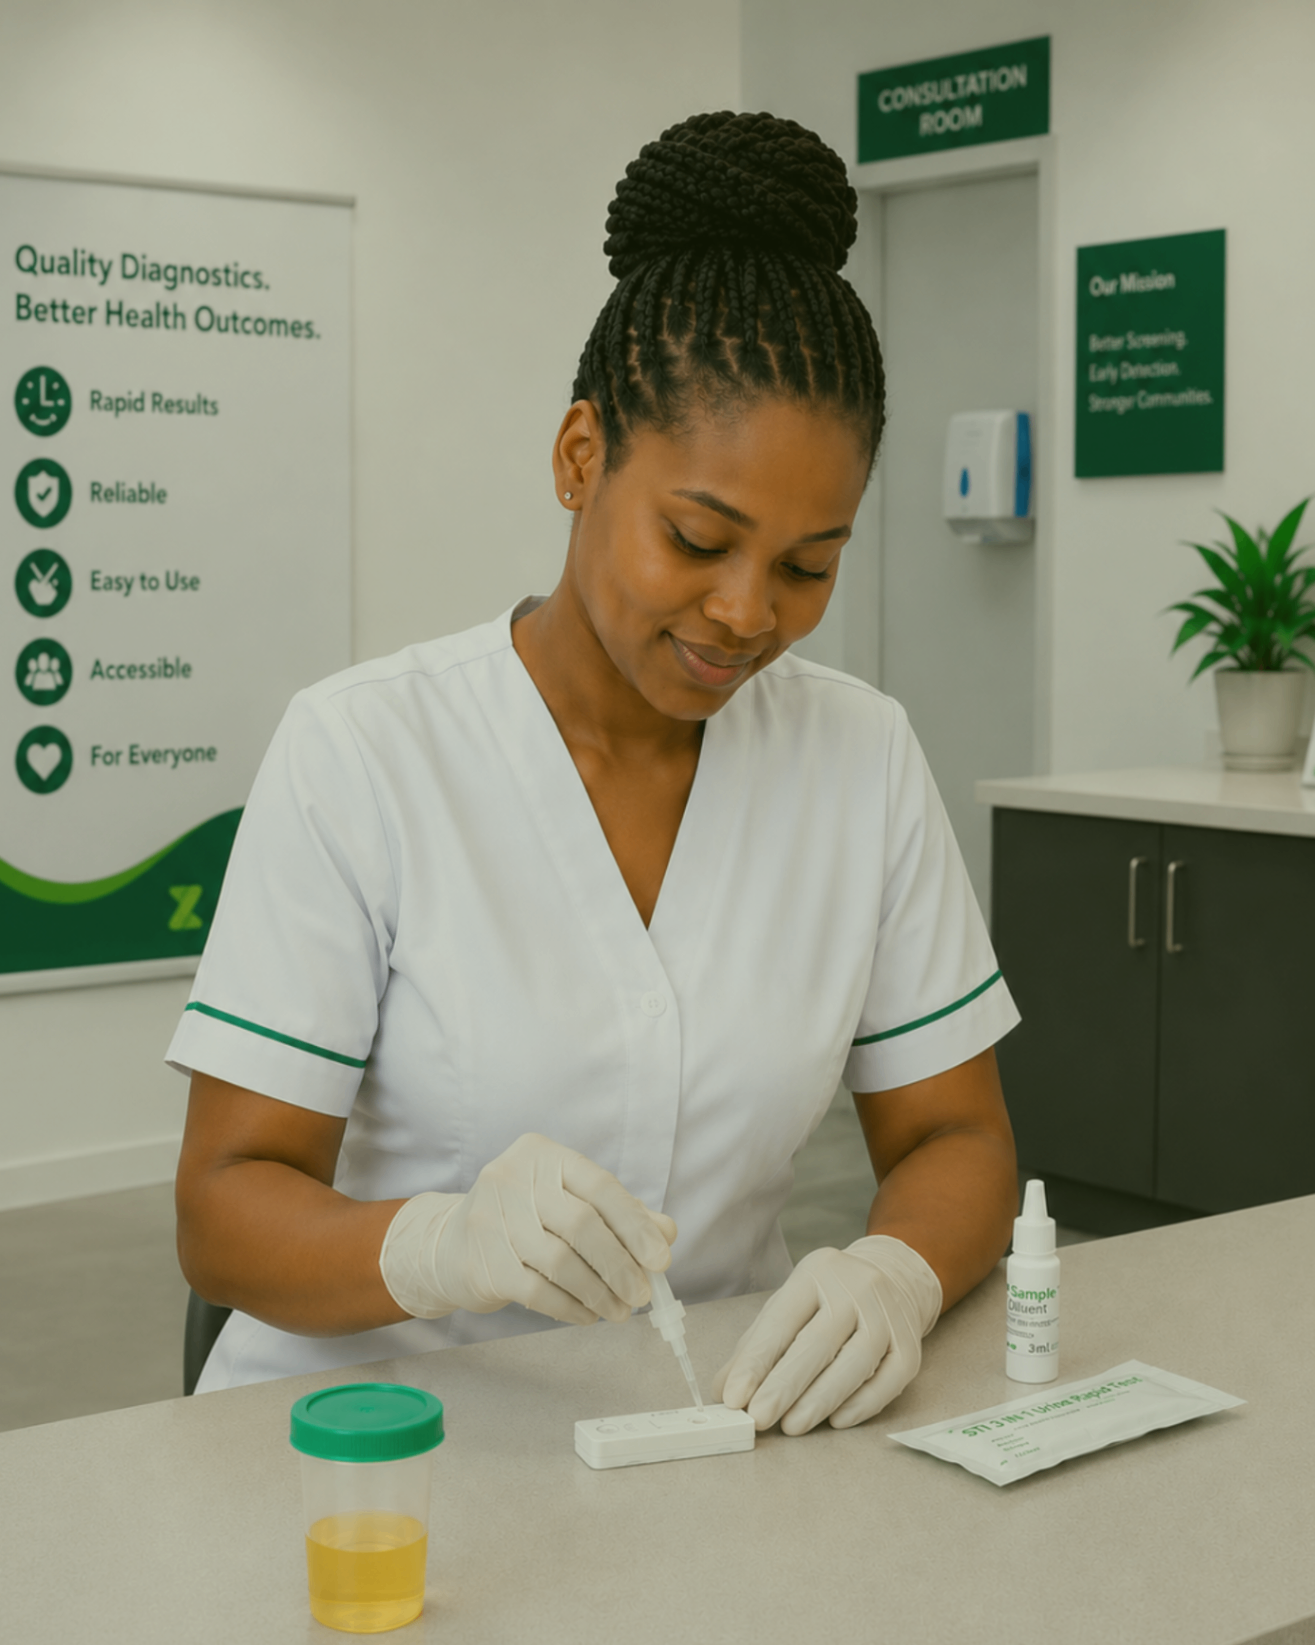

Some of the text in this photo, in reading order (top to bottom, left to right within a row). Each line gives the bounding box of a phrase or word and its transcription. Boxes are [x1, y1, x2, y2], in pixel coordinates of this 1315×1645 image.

[877, 63, 1028, 113] CONSULTATION
[919, 104, 983, 137] ROOM
[15, 245, 270, 291] Quality Diagnostics.
[1089, 269, 1176, 297] Our Mission
[16, 293, 321, 340] Better Health Outcomes.
[90, 390, 219, 418] Rapid Results
[90, 482, 168, 504] Reliable
[91, 569, 200, 597] Easy to Use
[90, 657, 192, 680] Accessible
[91, 745, 217, 770] For Everyone
[1011, 1285, 1057, 1303] Sample
